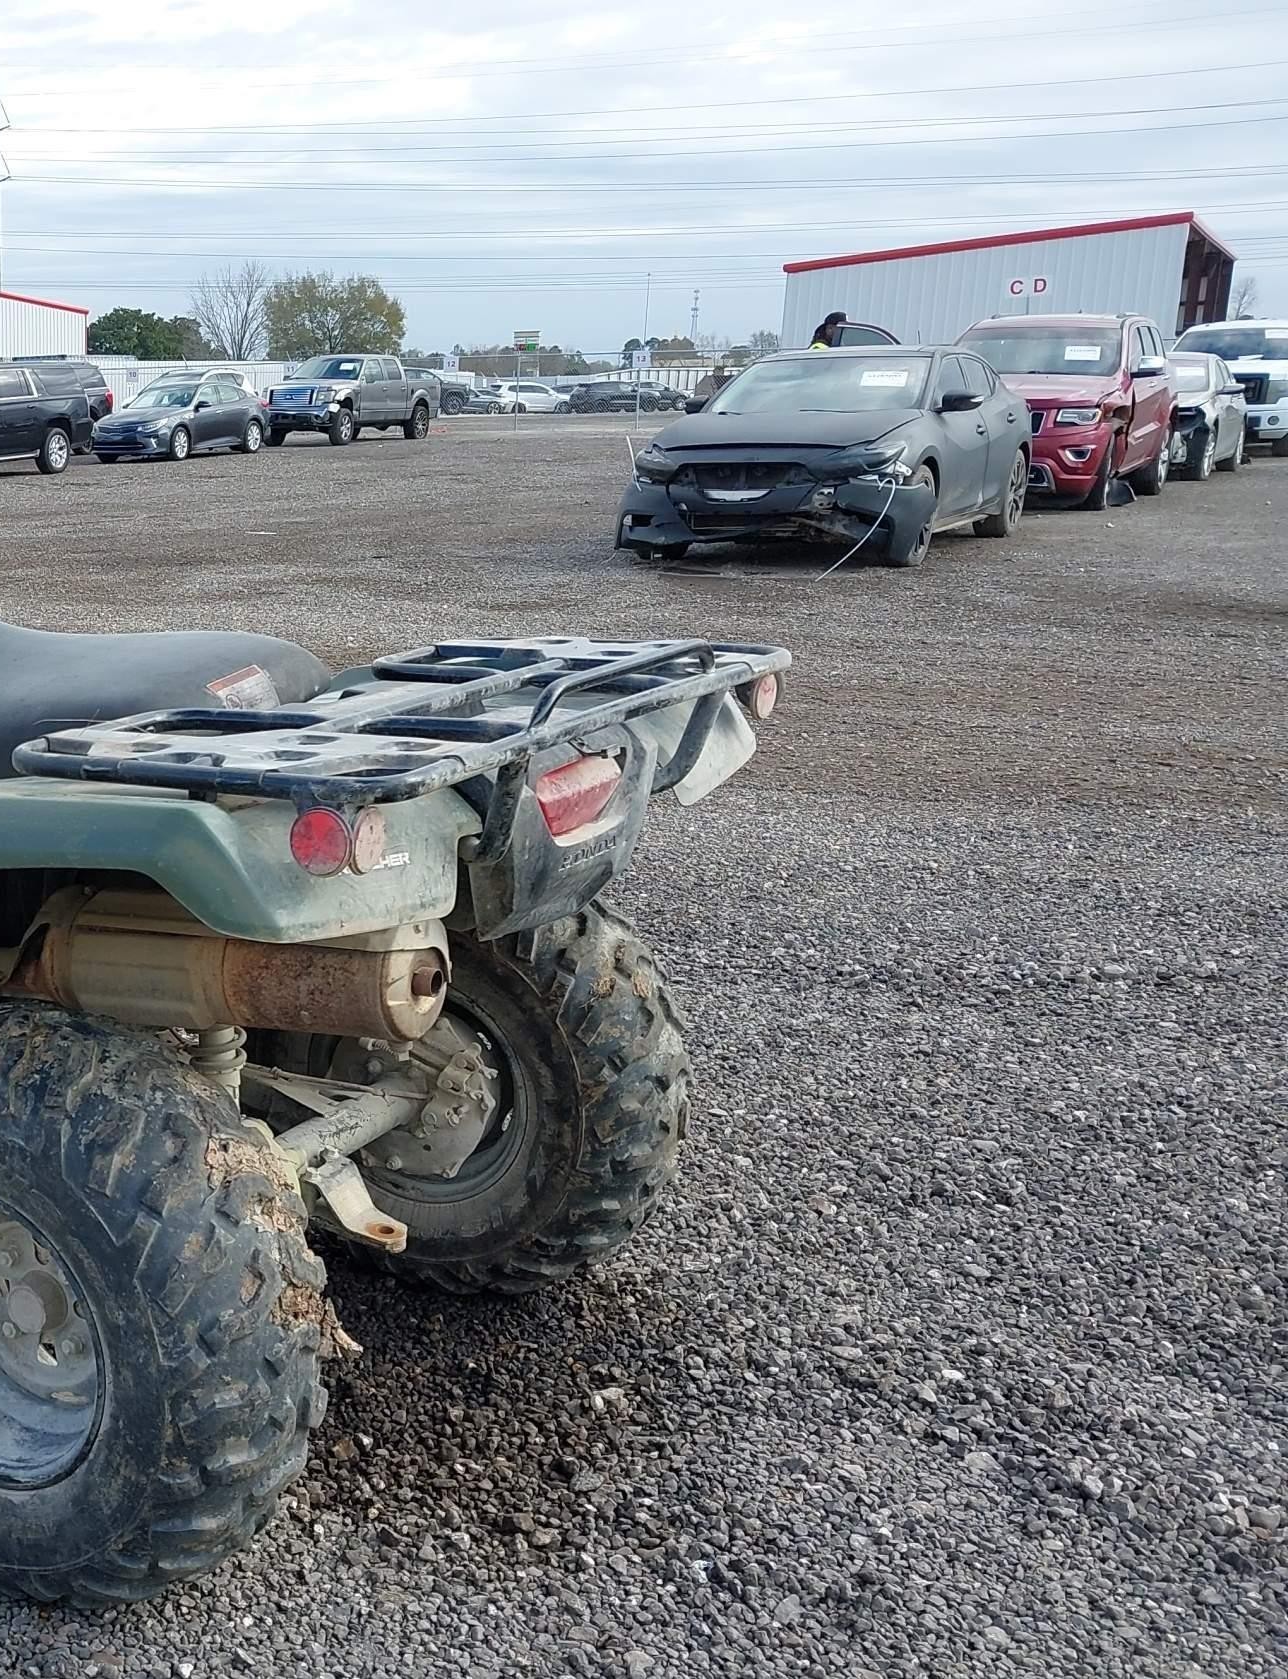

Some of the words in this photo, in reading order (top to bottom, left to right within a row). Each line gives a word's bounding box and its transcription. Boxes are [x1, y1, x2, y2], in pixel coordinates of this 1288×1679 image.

[1010, 279, 1024, 295] C
[1033, 278, 1047, 293] D
[447, 360, 456, 368] 12
[557, 835, 617, 873] HONDA
